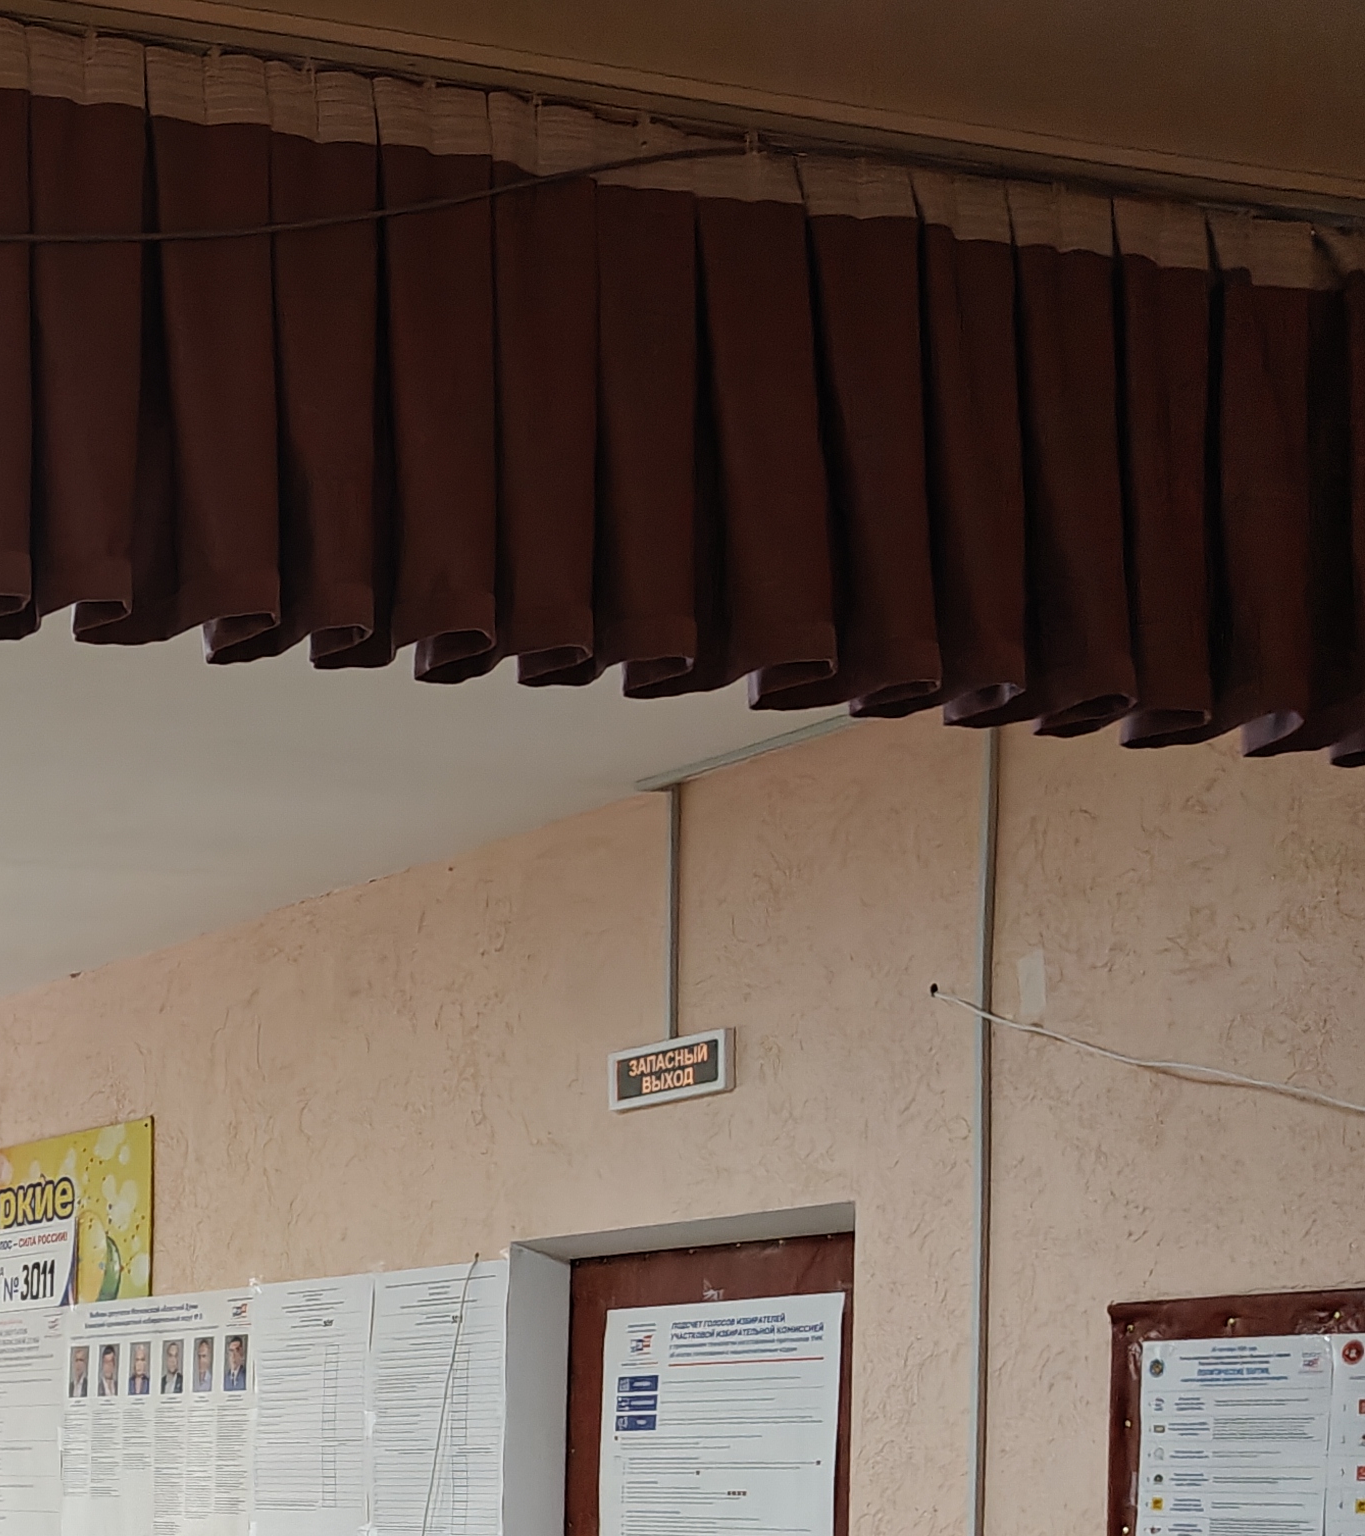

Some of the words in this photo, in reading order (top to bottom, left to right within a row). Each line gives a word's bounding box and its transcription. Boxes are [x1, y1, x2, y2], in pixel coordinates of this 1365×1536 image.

[629, 1043, 708, 1077] ЗАПАСНЫЙ
[642, 1067, 694, 1094] ВЫХОД
[18, 1235, 36, 1248] СИЛА
[20, 1259, 56, 1302] 3011
